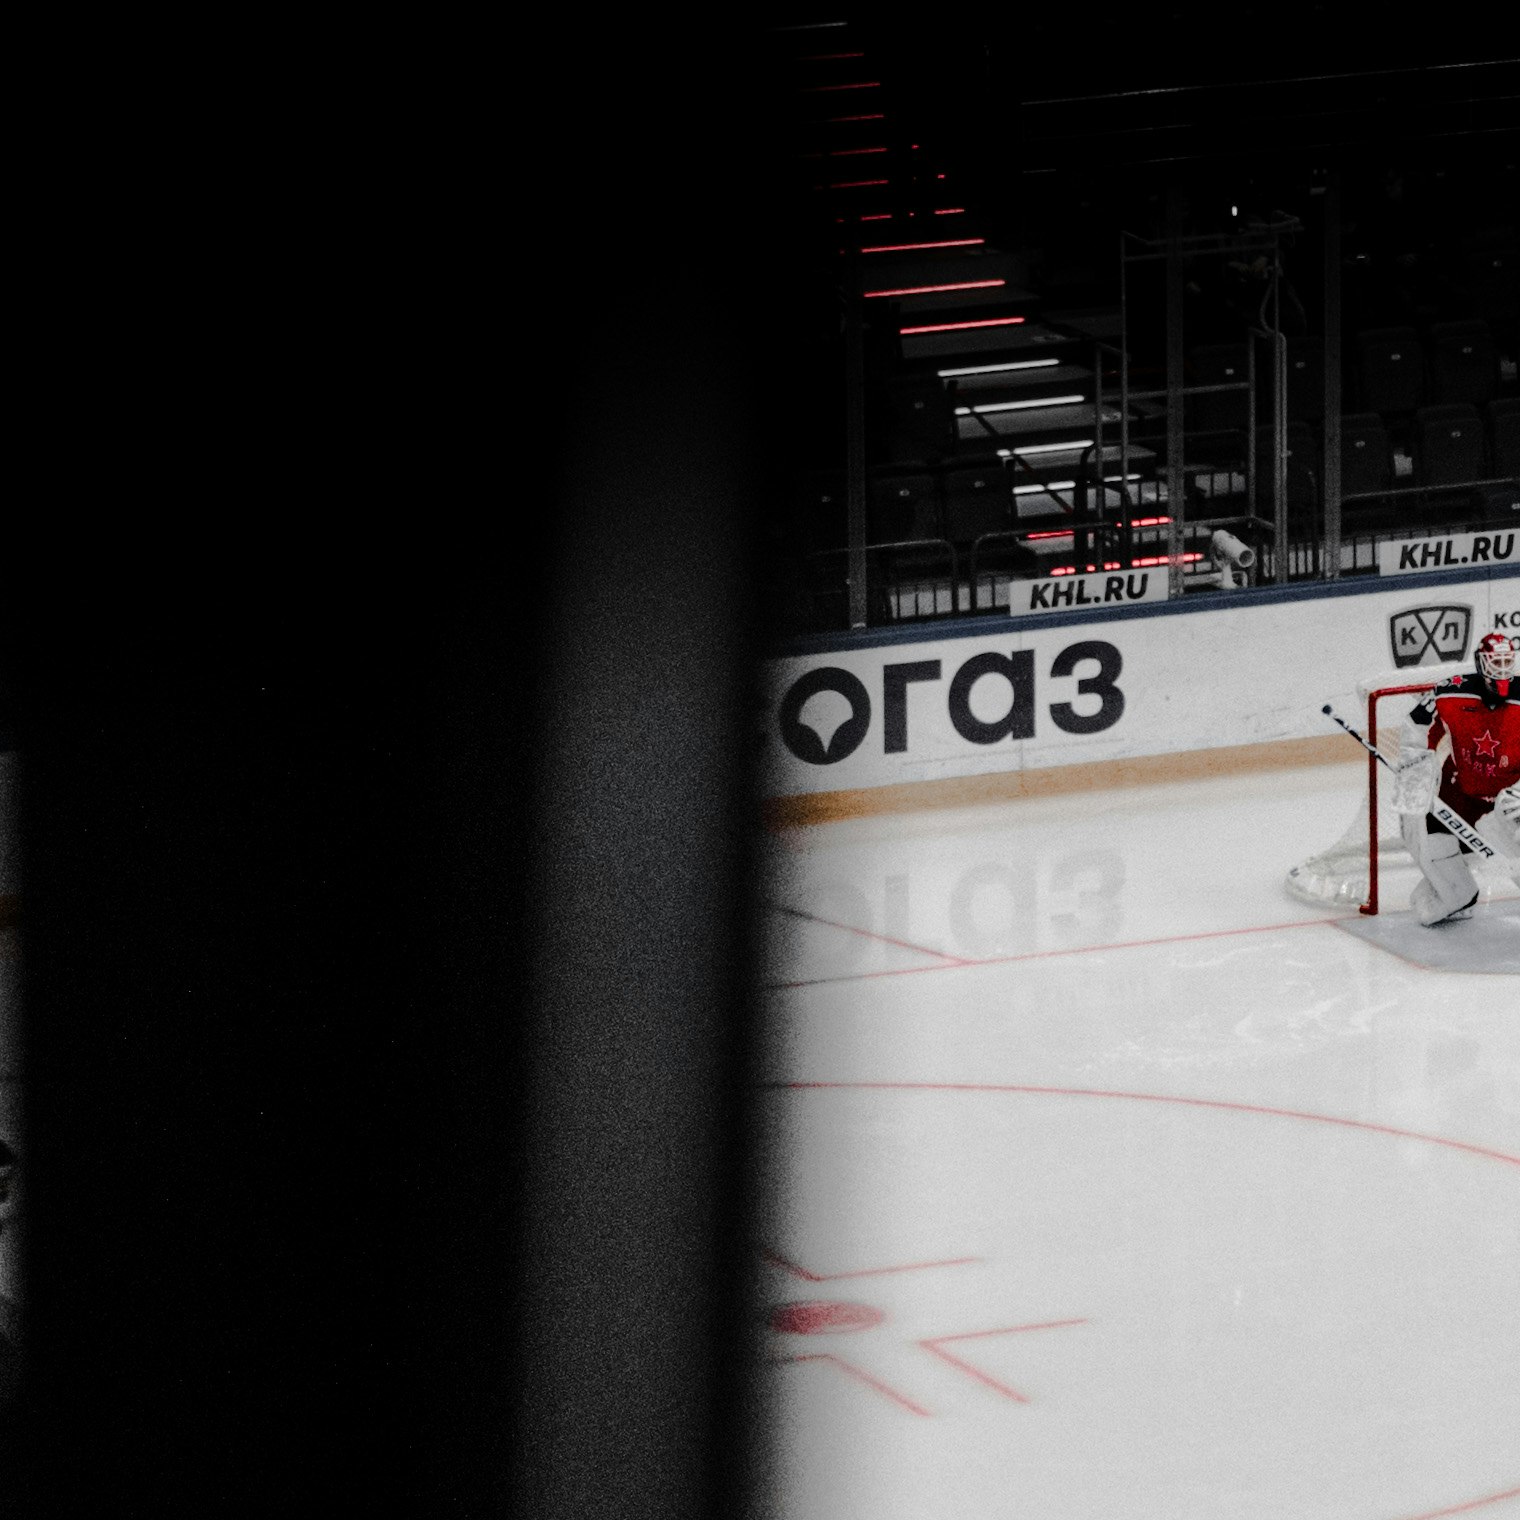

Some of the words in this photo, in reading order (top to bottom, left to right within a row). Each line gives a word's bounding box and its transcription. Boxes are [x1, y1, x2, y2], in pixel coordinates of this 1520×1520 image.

[1399, 533, 1515, 570] KHL.RU
[1029, 573, 1149, 610] KHL.RU
[779, 640, 1125, 765] огаз
